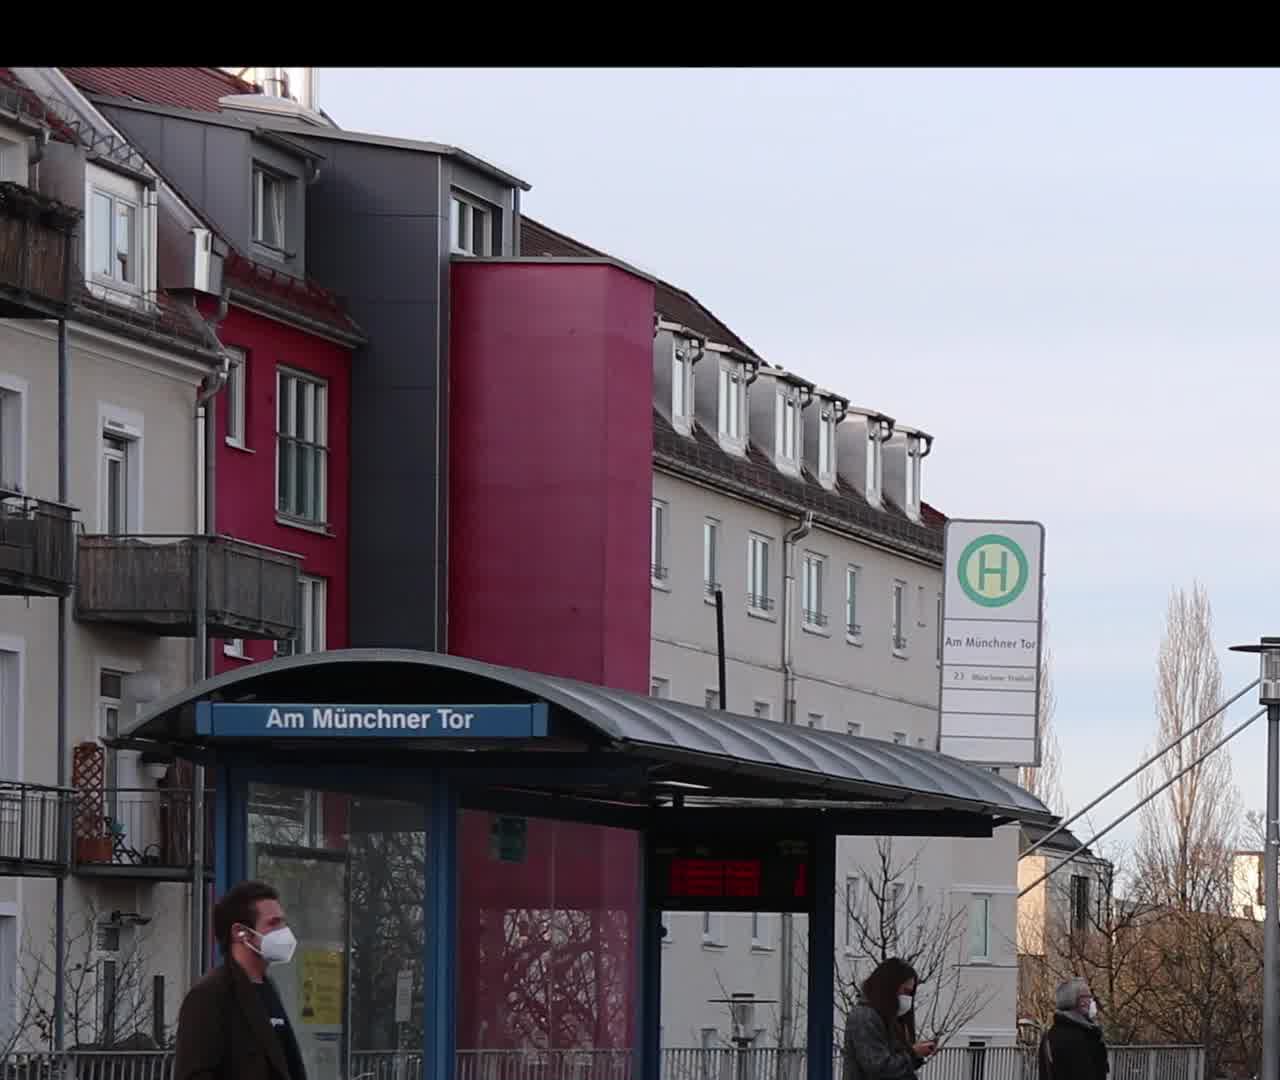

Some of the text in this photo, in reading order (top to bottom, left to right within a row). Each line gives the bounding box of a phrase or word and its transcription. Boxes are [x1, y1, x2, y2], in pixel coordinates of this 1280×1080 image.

[979, 550, 1008, 592] H
[945, 636, 962, 648] Am
[1021, 639, 1036, 649] Tor
[265, 707, 474, 729] Am Münchner Tor
